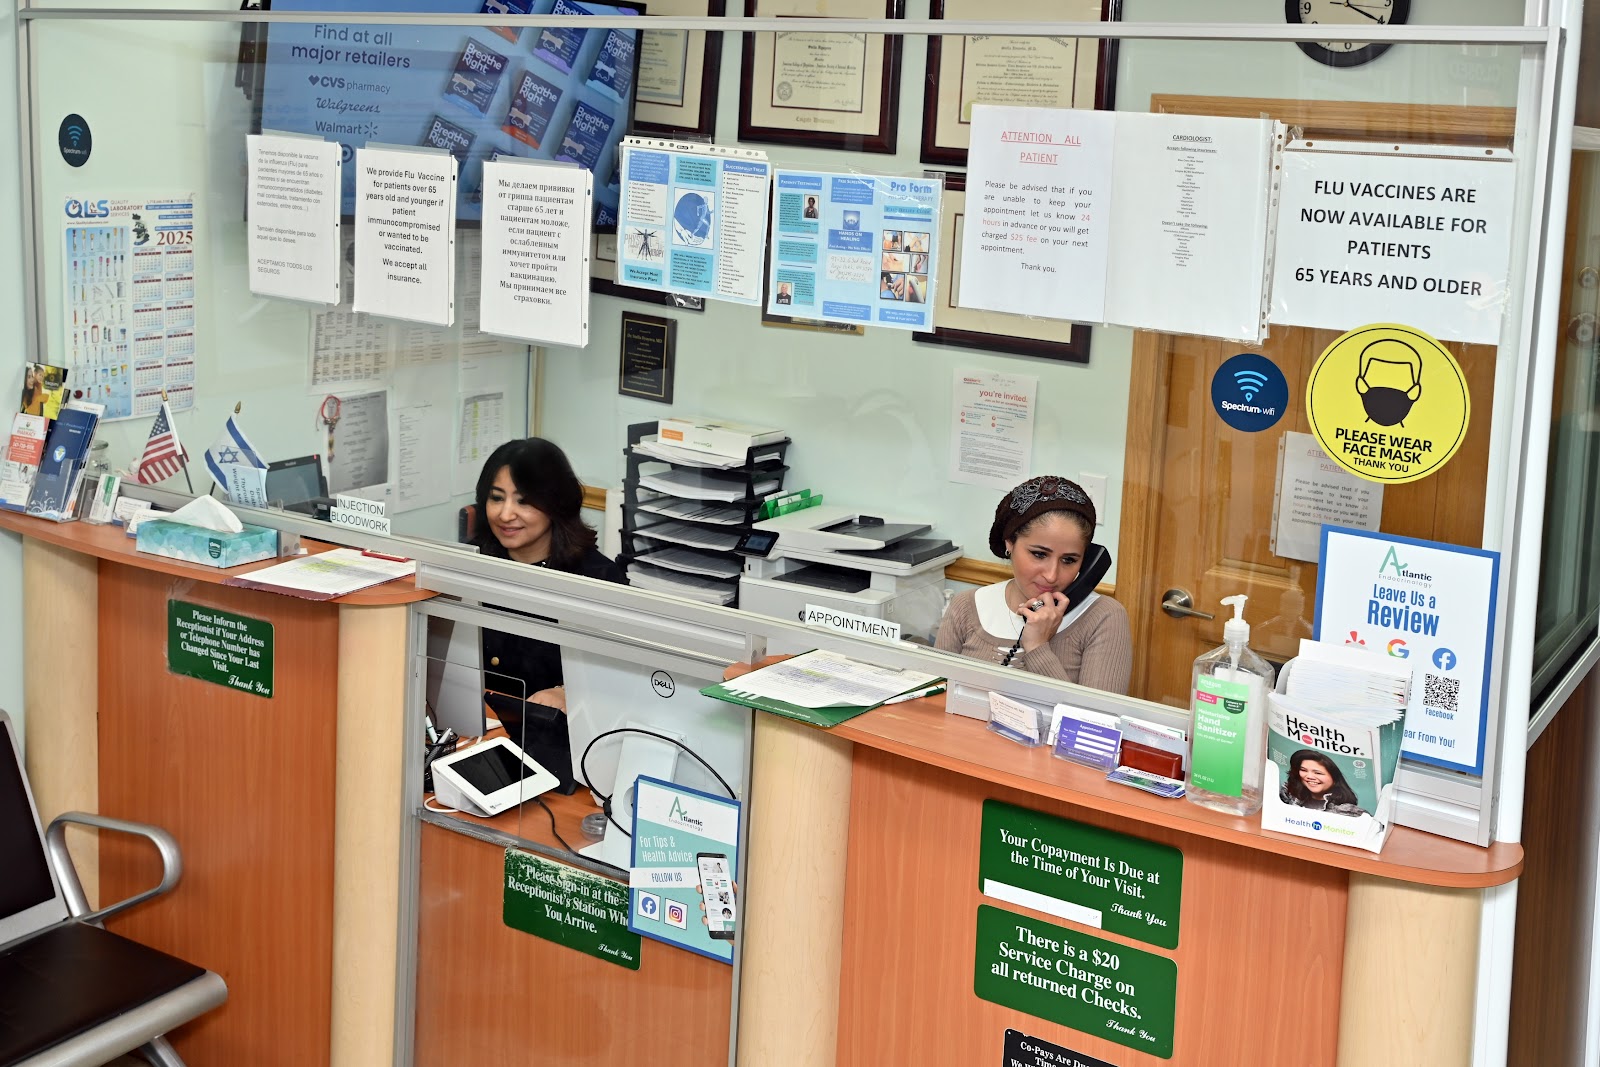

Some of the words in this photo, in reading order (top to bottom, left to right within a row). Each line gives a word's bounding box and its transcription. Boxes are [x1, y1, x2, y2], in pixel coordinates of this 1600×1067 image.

[314, 24, 349, 41] Find
[352, 30, 370, 44] at
[373, 32, 393, 46] all
[291, 45, 341, 65] major
[345, 51, 411, 68] retailers
[320, 76, 346, 89] CVS
[346, 81, 391, 95] pharmacy
[522, 76, 558, 103] Breathe
[519, 86, 546, 106] Right
[315, 97, 381, 114] Walgreens
[315, 120, 362, 135] Walmart
[1000, 131, 1053, 144] ATTENTION
[1064, 135, 1082, 145] ALL
[1172, 134, 1213, 143] CARDIOLOGIST:
[1019, 152, 1059, 164] PATIENT
[366, 167, 378, 175] We
[378, 169, 403, 178] provide
[404, 170, 415, 179] Flu
[417, 172, 445, 182] Vaccine
[373, 180, 383, 188] for
[383, 181, 411, 191] patients
[428, 186, 437, 194] 65
[498, 179, 511, 188] Мы
[511, 181, 538, 190] делаем
[539, 184, 575, 194] прививки
[890, 181, 907, 192] Pro
[909, 183, 932, 194] Form
[985, 180, 1006, 189] Please
[1009, 182, 1018, 191] be
[1021, 183, 1048, 193] advised
[1051, 186, 1065, 194] that
[1069, 187, 1075, 195] if
[1078, 188, 1093, 197] you
[1314, 180, 1345, 195] FLU
[1349, 182, 1437, 201] VACCINES
[1440, 187, 1477, 203] ARE
[65, 199, 110, 218] QLS
[392, 208, 416, 216] patient
[367, 216, 441, 232] immunocompromised
[1300, 208, 1345, 224] NOW
[1348, 211, 1446, 231] AVAILABLE
[1450, 217, 1488, 234] FOR
[156, 230, 193, 246] 2025
[509, 238, 559, 250] ослабленным
[384, 243, 423, 254] vaccinated.
[1347, 239, 1432, 260] PATIENTS
[257, 258, 286, 268] ACEPTAMOS
[286, 261, 302, 270] TODOS
[303, 264, 313, 272] LOS
[257, 266, 280, 275] SEGUROS
[382, 258, 394, 266] We
[394, 261, 418, 270] accept
[418, 263, 427, 271] all
[1020, 262, 1041, 272] Thank
[1042, 263, 1057, 274] you.
[387, 273, 422, 284] insurance.
[509, 271, 557, 283] вакцинацию.
[1294, 267, 1315, 282] 65
[1319, 269, 1373, 287] YEARS
[1377, 274, 1418, 291] AND
[1422, 277, 1483, 297] OLDER
[499, 280, 512, 289] Мы
[513, 283, 555, 294] принимаем
[555, 288, 567, 296] все
[513, 294, 553, 306] страховки.
[979, 389, 1002, 399] you're
[1003, 391, 1029, 403] invited.
[1221, 400, 1261, 414] Spectrum
[1262, 407, 1276, 416] wifi
[1335, 427, 1386, 446] PLEASE
[1389, 435, 1433, 453] WEAR
[1342, 442, 1377, 459] FACE
[1379, 448, 1423, 465] MASK
[1353, 457, 1387, 470] THANK
[1388, 462, 1410, 474] YOU
[337, 498, 384, 516] INJECTION
[331, 511, 388, 533] BLOODWORK
[1378, 545, 1433, 582] Atlantic
[1378, 573, 1433, 589] Endocrinology
[1373, 583, 1407, 603] Leave
[1410, 590, 1425, 607] Us
[1428, 595, 1436, 609] a
[192, 609, 213, 623] Please
[213, 614, 236, 629] Inform
[236, 621, 248, 632] the
[807, 609, 898, 640] APPOINTMENT
[1367, 599, 1440, 637] Review
[176, 617, 214, 636] Receptionist
[215, 628, 222, 636] if
[221, 628, 237, 641] Your
[238, 633, 265, 648] Address
[212, 660, 229, 673] Visit.
[227, 674, 254, 690] Thank
[255, 681, 270, 695] You
[654, 678, 673, 690] DELL
[1200, 679, 1222, 689] amazon
[1197, 708, 1231, 721] Moisturizing
[1197, 714, 1221, 727] Hand
[1424, 707, 1454, 721] Facebook
[1079, 724, 1103, 734] Appointment
[1197, 724, 1238, 738] Sanitizer
[1285, 714, 1345, 743] Health
[668, 817, 704, 832] Endocrinology
[639, 836, 651, 849] For
[653, 835, 668, 849] Tips
[669, 835, 676, 848] &
[641, 850, 667, 863] Health
[668, 849, 694, 863] Advice
[999, 828, 1028, 845] Your
[1031, 837, 1101, 868] Copayment
[1103, 856, 1116, 873] Is
[1118, 861, 1144, 880] Due
[1147, 871, 1161, 885] at
[651, 872, 672, 883] FOLLOW
[673, 872, 683, 882] US
[1010, 850, 1029, 866] the
[1031, 854, 1063, 876] Time
[1065, 866, 1079, 880] of
[1080, 868, 1111, 889] Your
[1113, 877, 1146, 900] Visit.
[526, 865, 555, 883] Please
[556, 872, 590, 897] Sign-in
[591, 890, 603, 901] at
[604, 891, 620, 906] the
[507, 875, 571, 909] Receptionist's
[572, 896, 607, 920] Station
[544, 904, 563, 925] You
[564, 911, 598, 934] Arrive.
[1110, 902, 1144, 920] Thank
[1144, 911, 1168, 928] You
[1015, 925, 1060, 952] There
[1063, 940, 1076, 957] is
[1078, 948, 1088, 961] a
[1091, 949, 1120, 971] $20
[999, 941, 1052, 971] Service
[1055, 958, 1112, 990] Charge
[1115, 981, 1135, 997] on
[990, 961, 1009, 978] all
[1012, 970, 1078, 1000] returned
[1081, 988, 1142, 1020] Checks.
[1020, 1041, 1054, 1060] Co-Pays
[1055, 1054, 1071, 1066] Are
